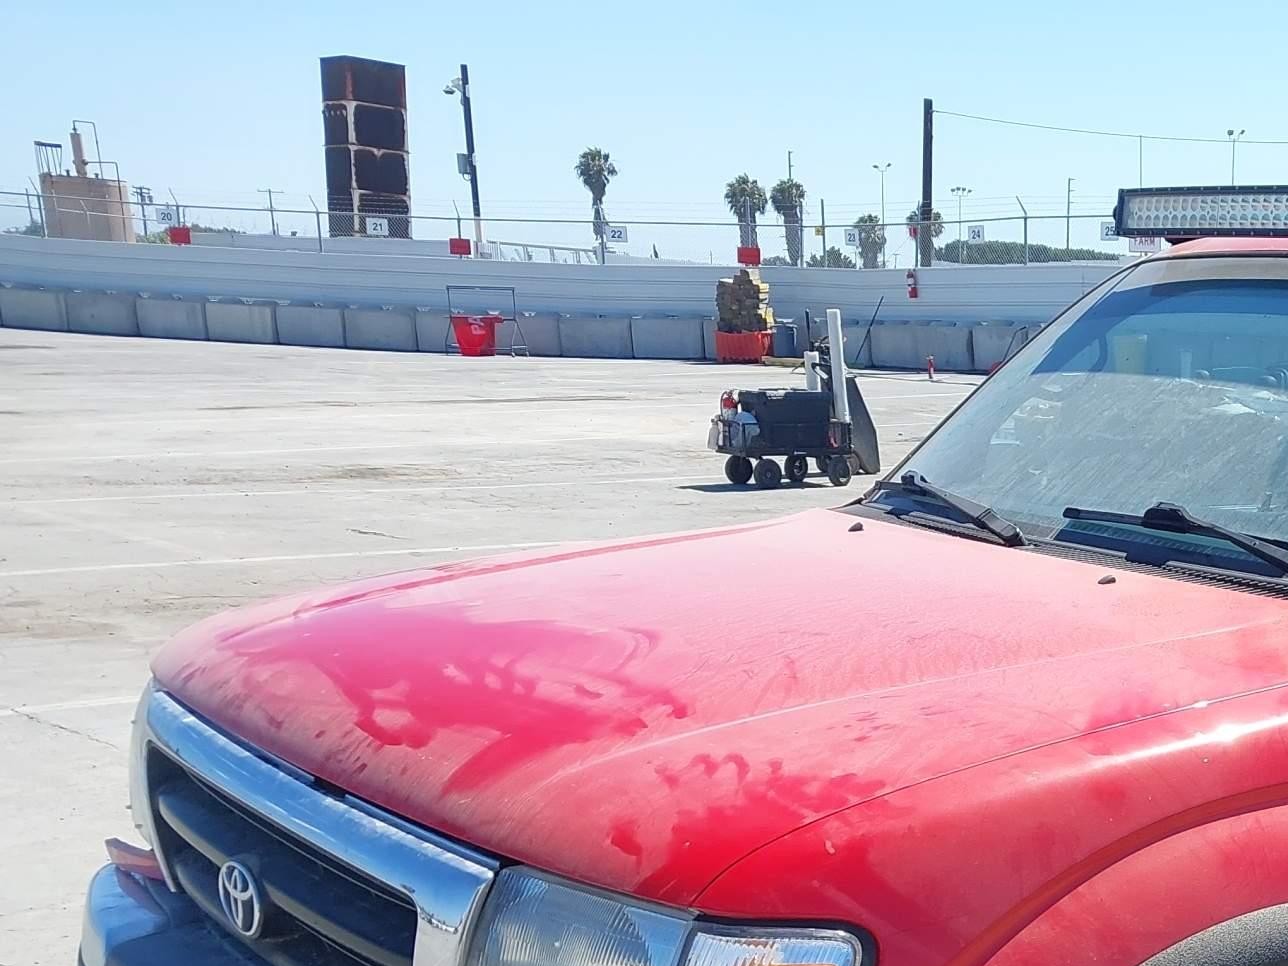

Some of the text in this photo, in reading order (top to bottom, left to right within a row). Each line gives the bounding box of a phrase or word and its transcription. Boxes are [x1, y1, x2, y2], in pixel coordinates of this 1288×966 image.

[160, 212, 173, 222] 20
[372, 222, 384, 232] 21
[610, 229, 623, 239] 22
[847, 233, 856, 243] 23
[971, 229, 981, 240] 24
